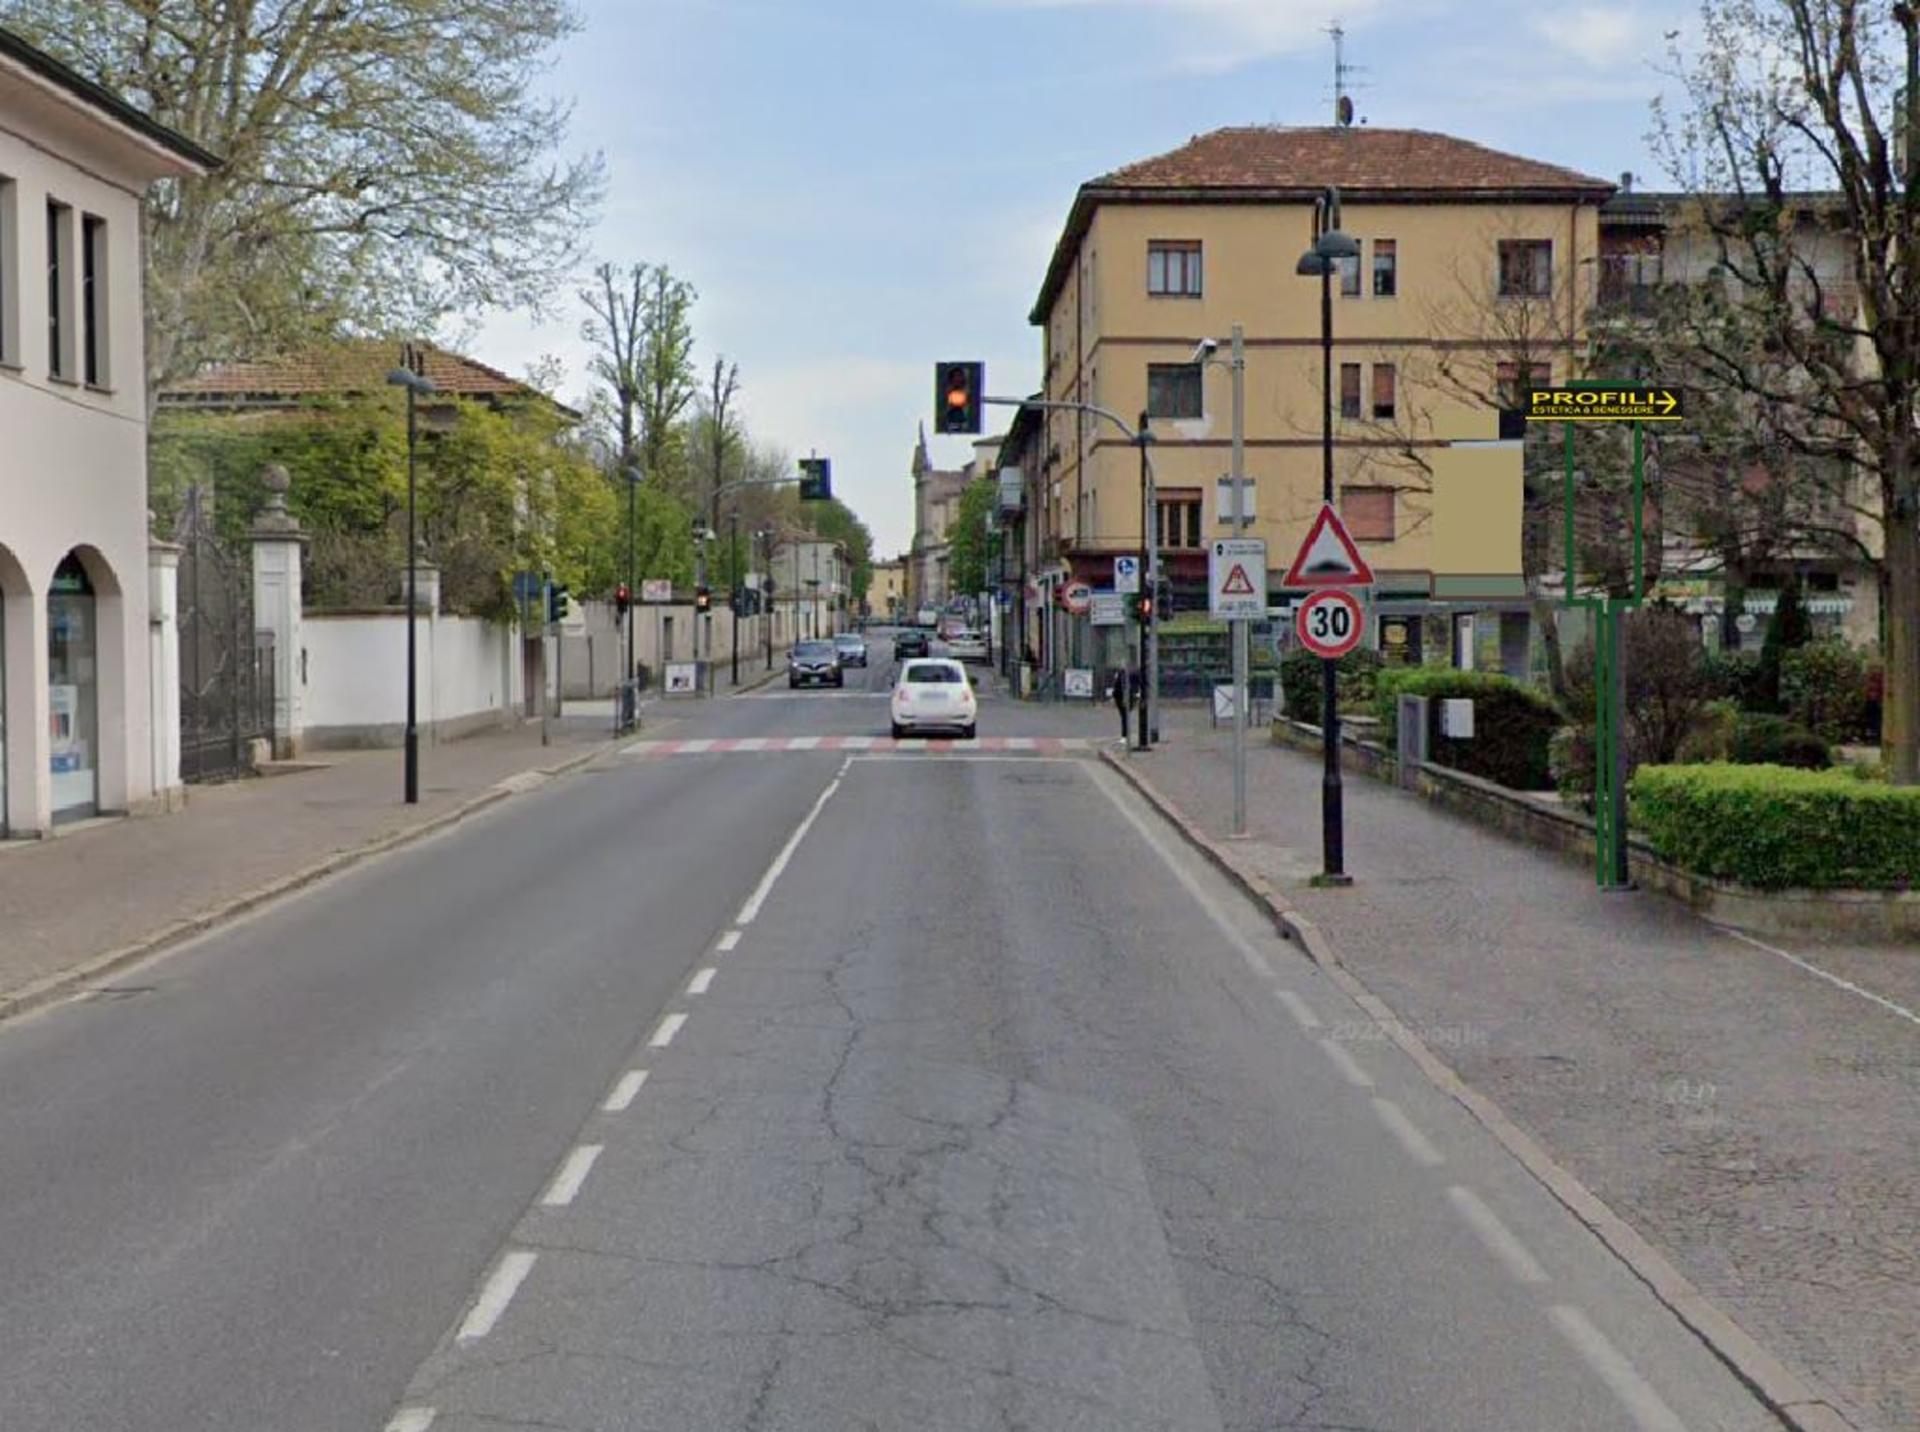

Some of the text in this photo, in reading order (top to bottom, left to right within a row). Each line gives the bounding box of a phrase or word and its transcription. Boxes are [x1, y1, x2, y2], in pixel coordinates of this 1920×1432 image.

[1532, 392, 1654, 405] PROFILI
[1532, 405, 1582, 415] ESTETICA
[1593, 405, 1655, 415] BENESSERE
[1314, 606, 1350, 638] 30
